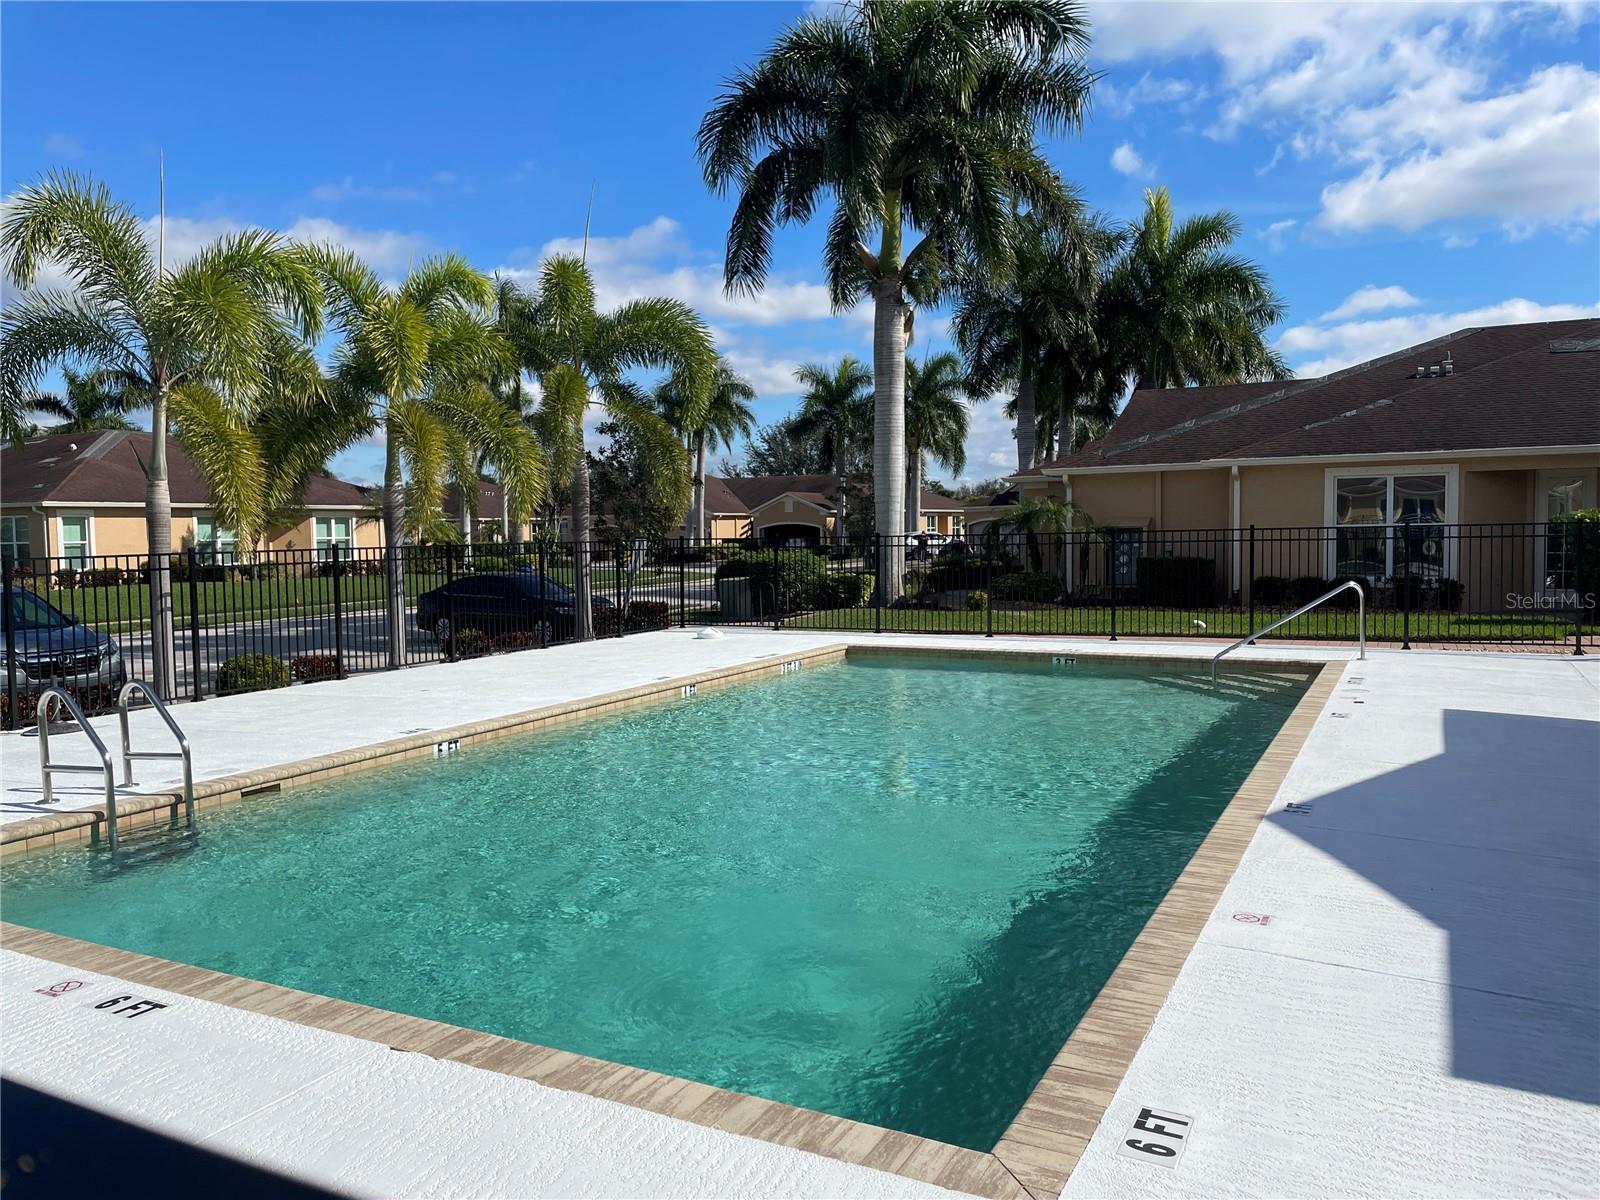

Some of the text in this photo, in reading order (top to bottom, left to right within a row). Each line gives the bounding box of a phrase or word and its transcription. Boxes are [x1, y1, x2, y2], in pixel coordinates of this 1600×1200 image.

[94, 995, 168, 1018] 6 FT
[1125, 1107, 1189, 1157] 6 FT
